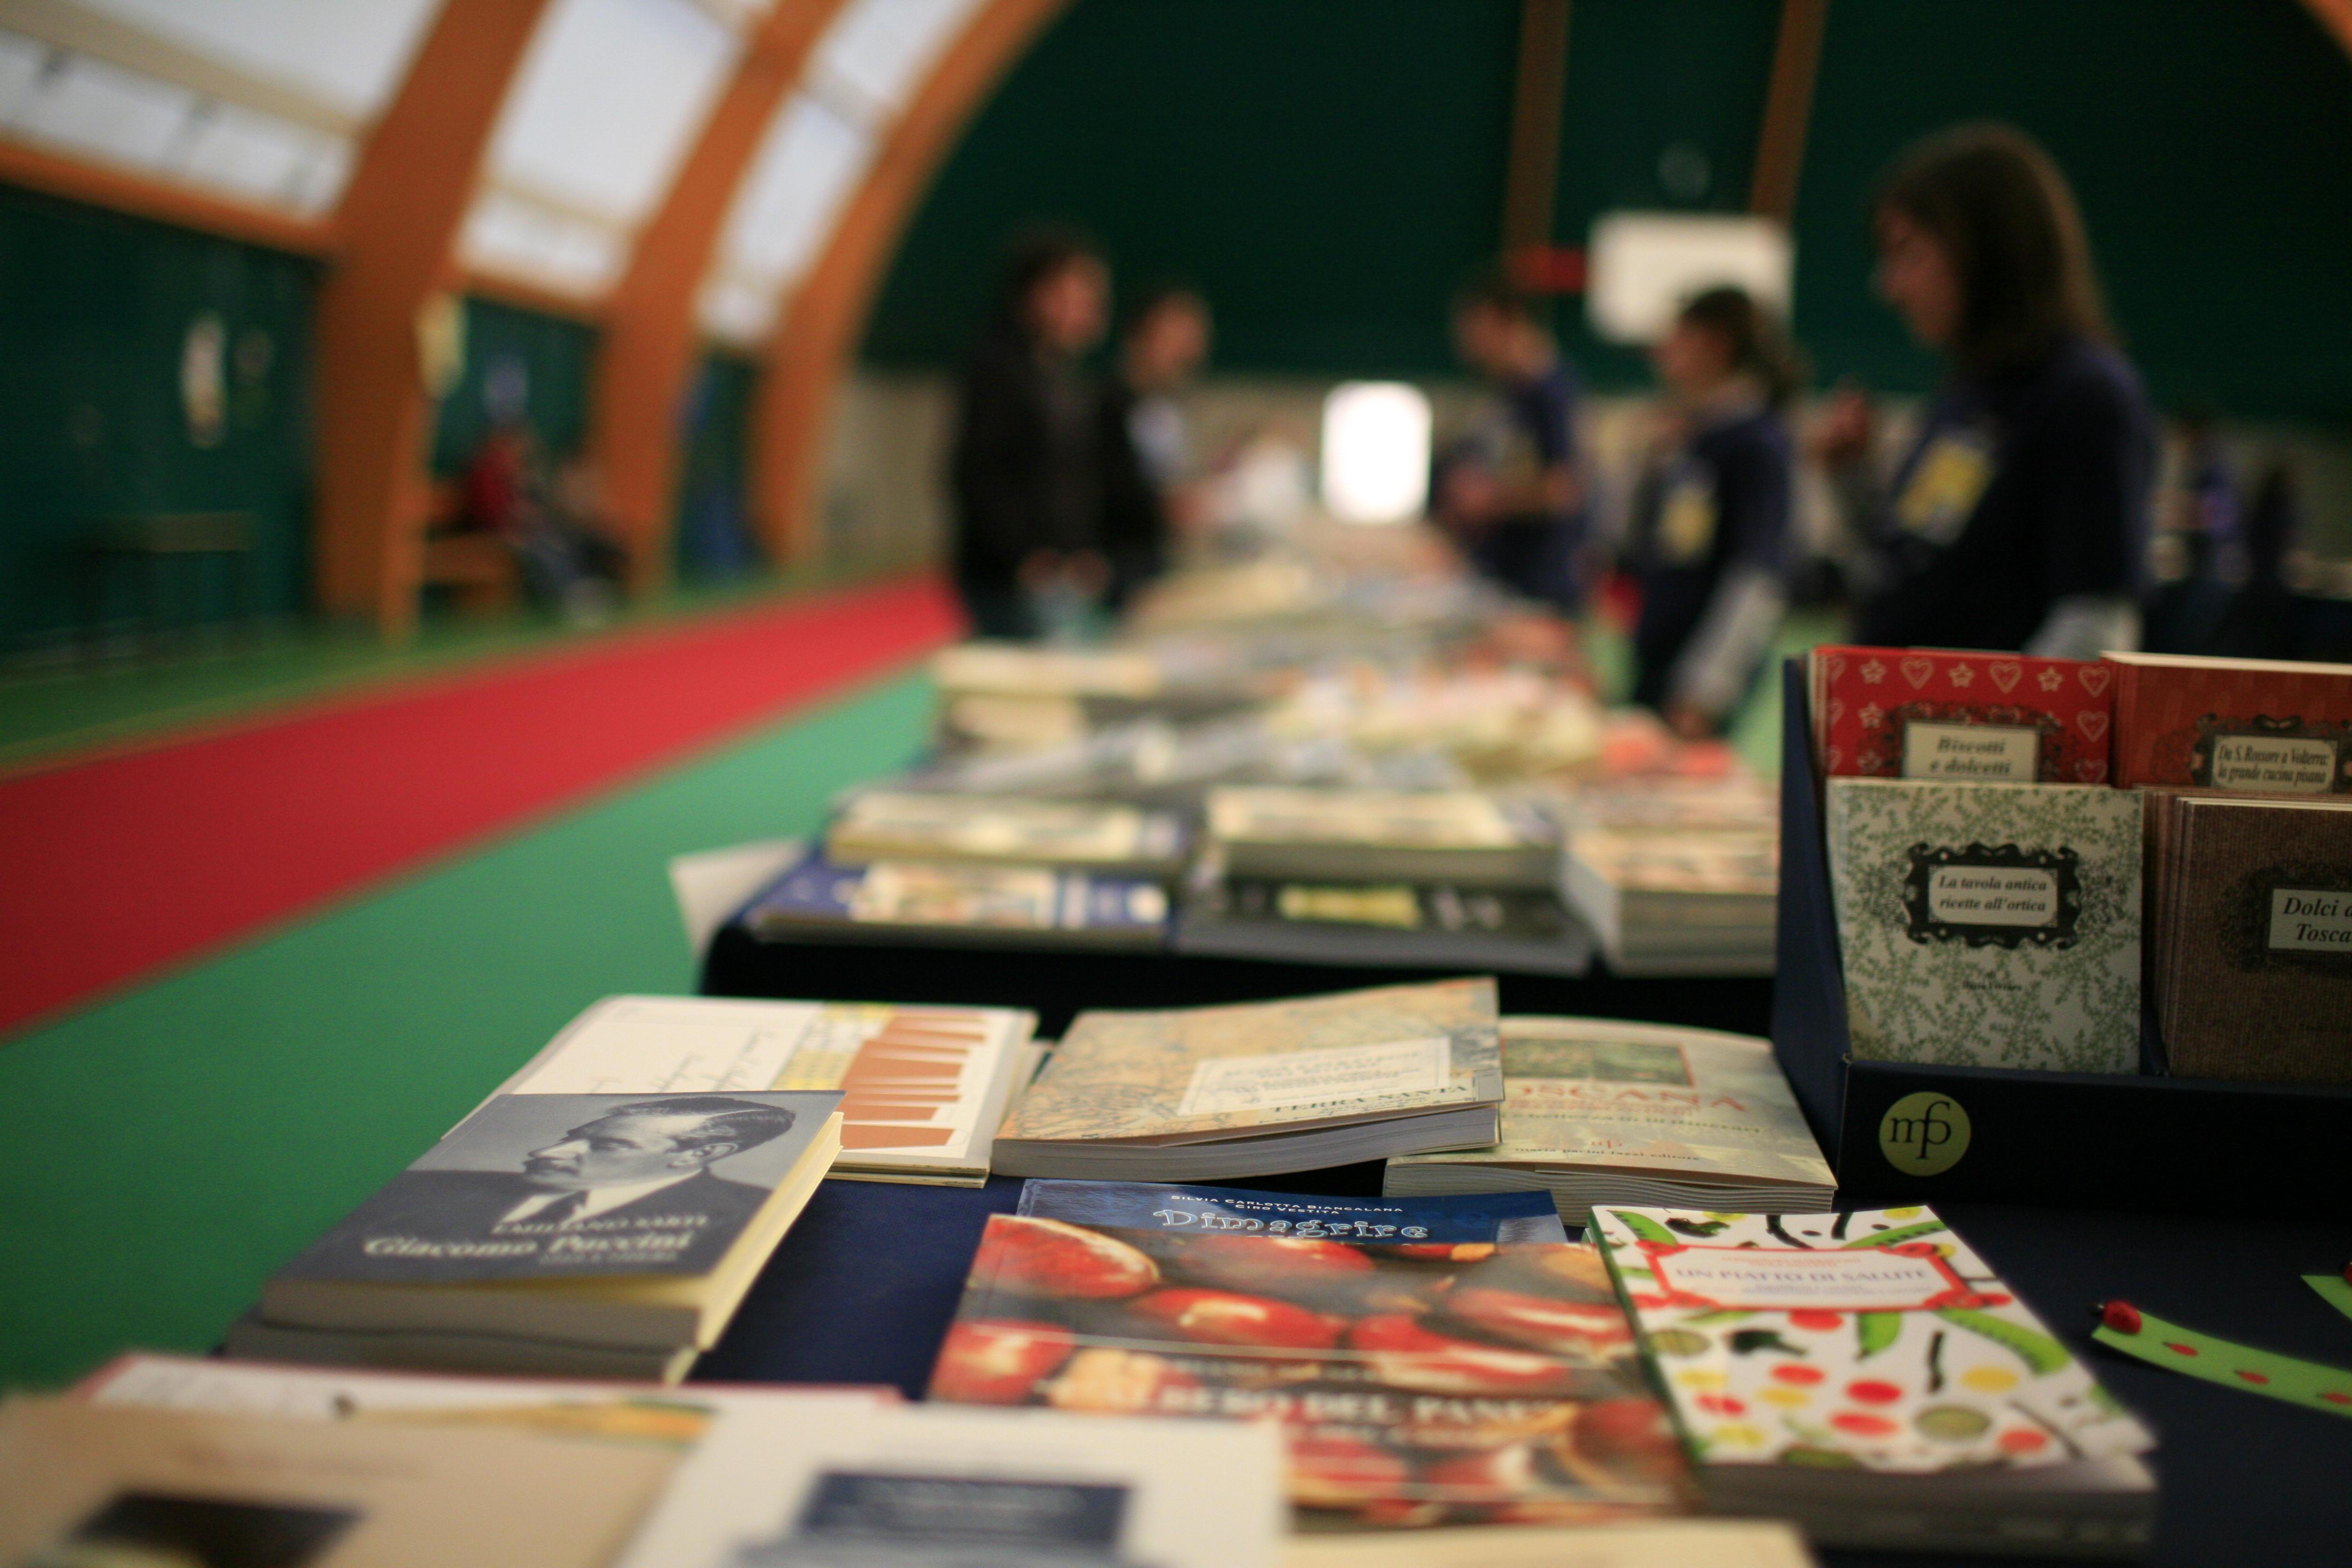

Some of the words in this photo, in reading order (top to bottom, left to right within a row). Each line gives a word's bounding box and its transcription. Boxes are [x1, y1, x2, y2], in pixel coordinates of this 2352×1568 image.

[1937, 736, 2006, 753] Biscotti
[2244, 745, 2280, 763] Rossore
[1929, 760, 1940, 773] e
[1944, 755, 2011, 774] dolcetti
[2228, 763, 2260, 784] grande
[2263, 767, 2293, 781] cucina
[2294, 769, 2327, 787] pisana
[1940, 876, 1957, 888] La
[1961, 876, 2001, 889] tavola
[2005, 878, 2047, 891] antica
[1940, 895, 1982, 909] ricette
[1985, 897, 2046, 912] all'ortica
[2283, 897, 2340, 916] Dolci
[1271, 1097, 1364, 1113] TERRA
[1377, 1085, 1467, 1100] SANTA
[1224, 1199, 1301, 1208] CARLOTTA
[1154, 1209, 1429, 1239] Dimagrire
[363, 1236, 538, 1257] Giacomo
[547, 1230, 695, 1255] Puccini
[1676, 1268, 1713, 1279] UN
[1720, 1270, 1803, 1282] PIATTO
[1810, 1271, 1835, 1283] DI
[1840, 1269, 1927, 1282] SALUTE
